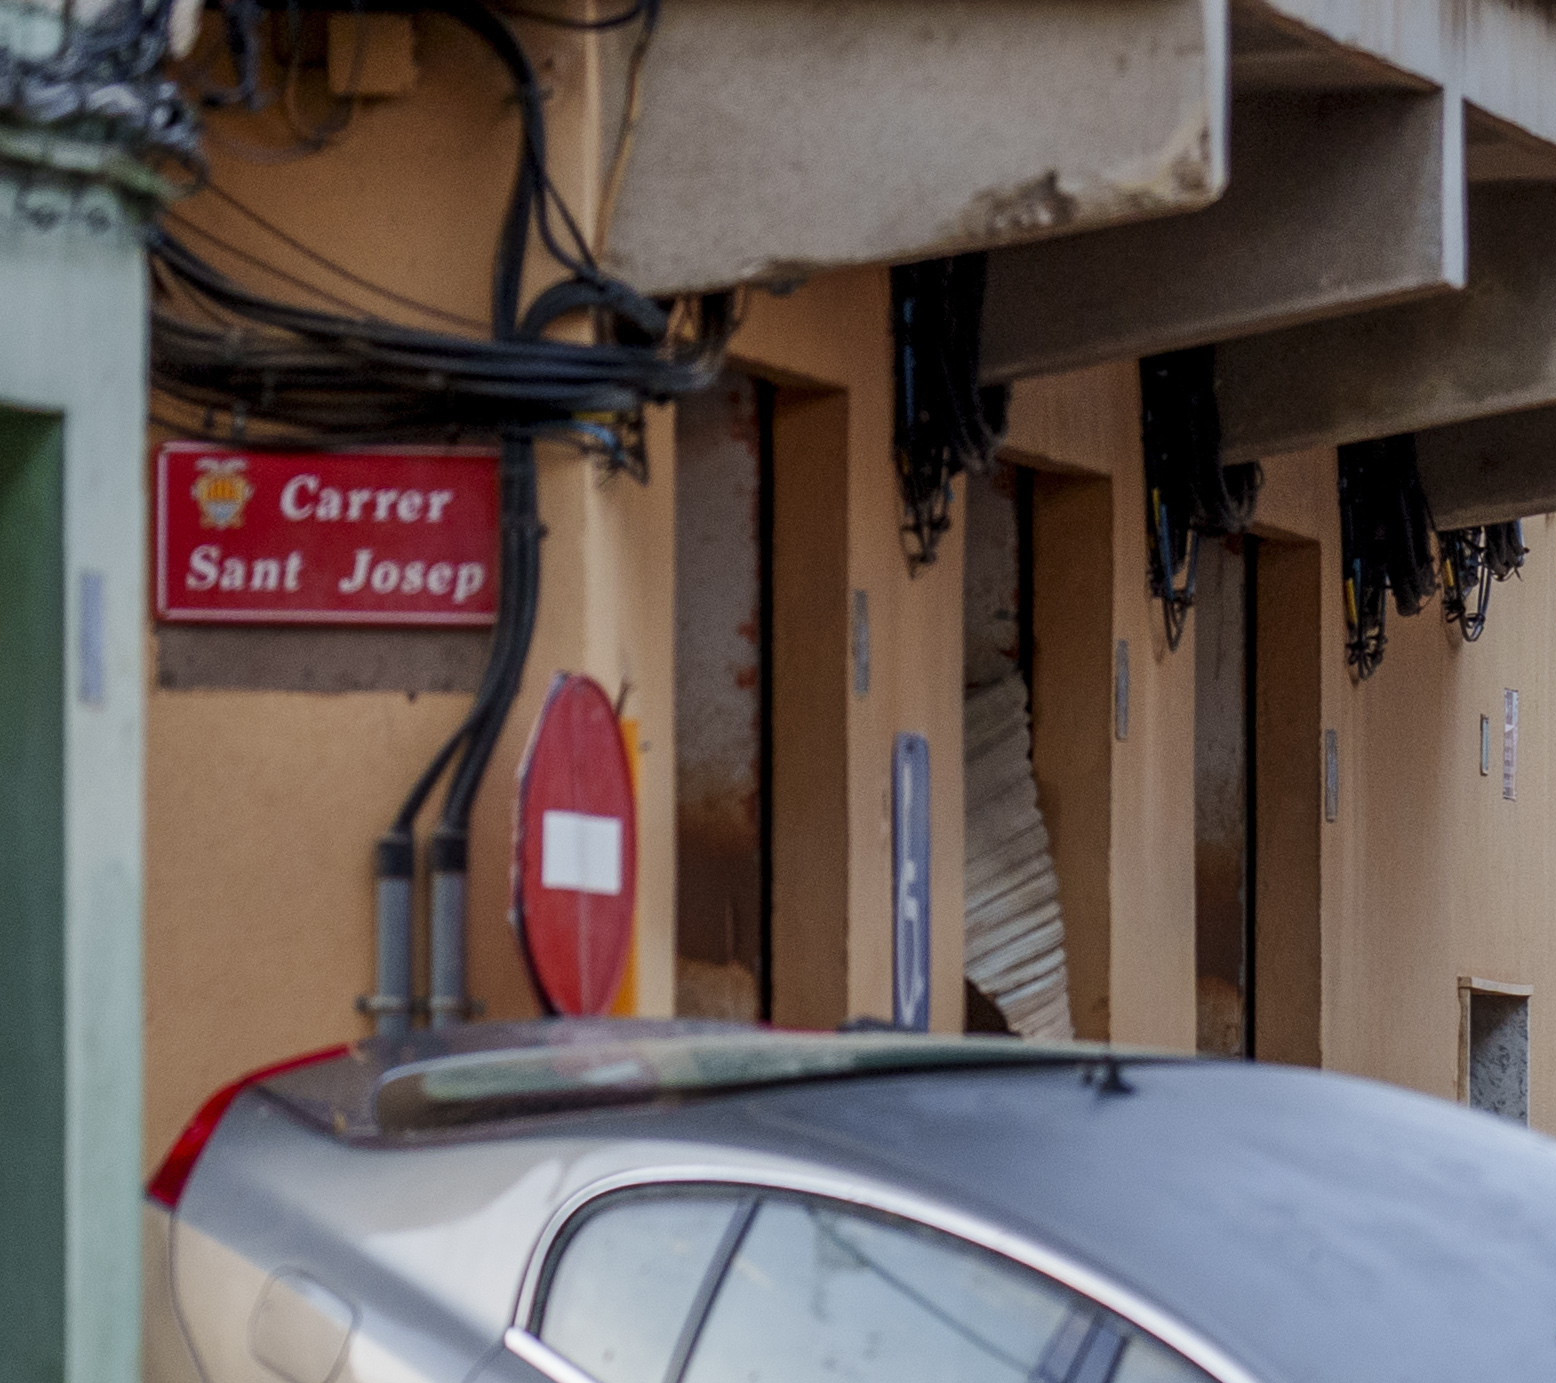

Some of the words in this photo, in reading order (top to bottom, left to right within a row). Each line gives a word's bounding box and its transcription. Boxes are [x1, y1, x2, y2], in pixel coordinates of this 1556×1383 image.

[280, 473, 453, 523] Carrer
[186, 544, 303, 593] Sant
[338, 549, 486, 604] Josep
